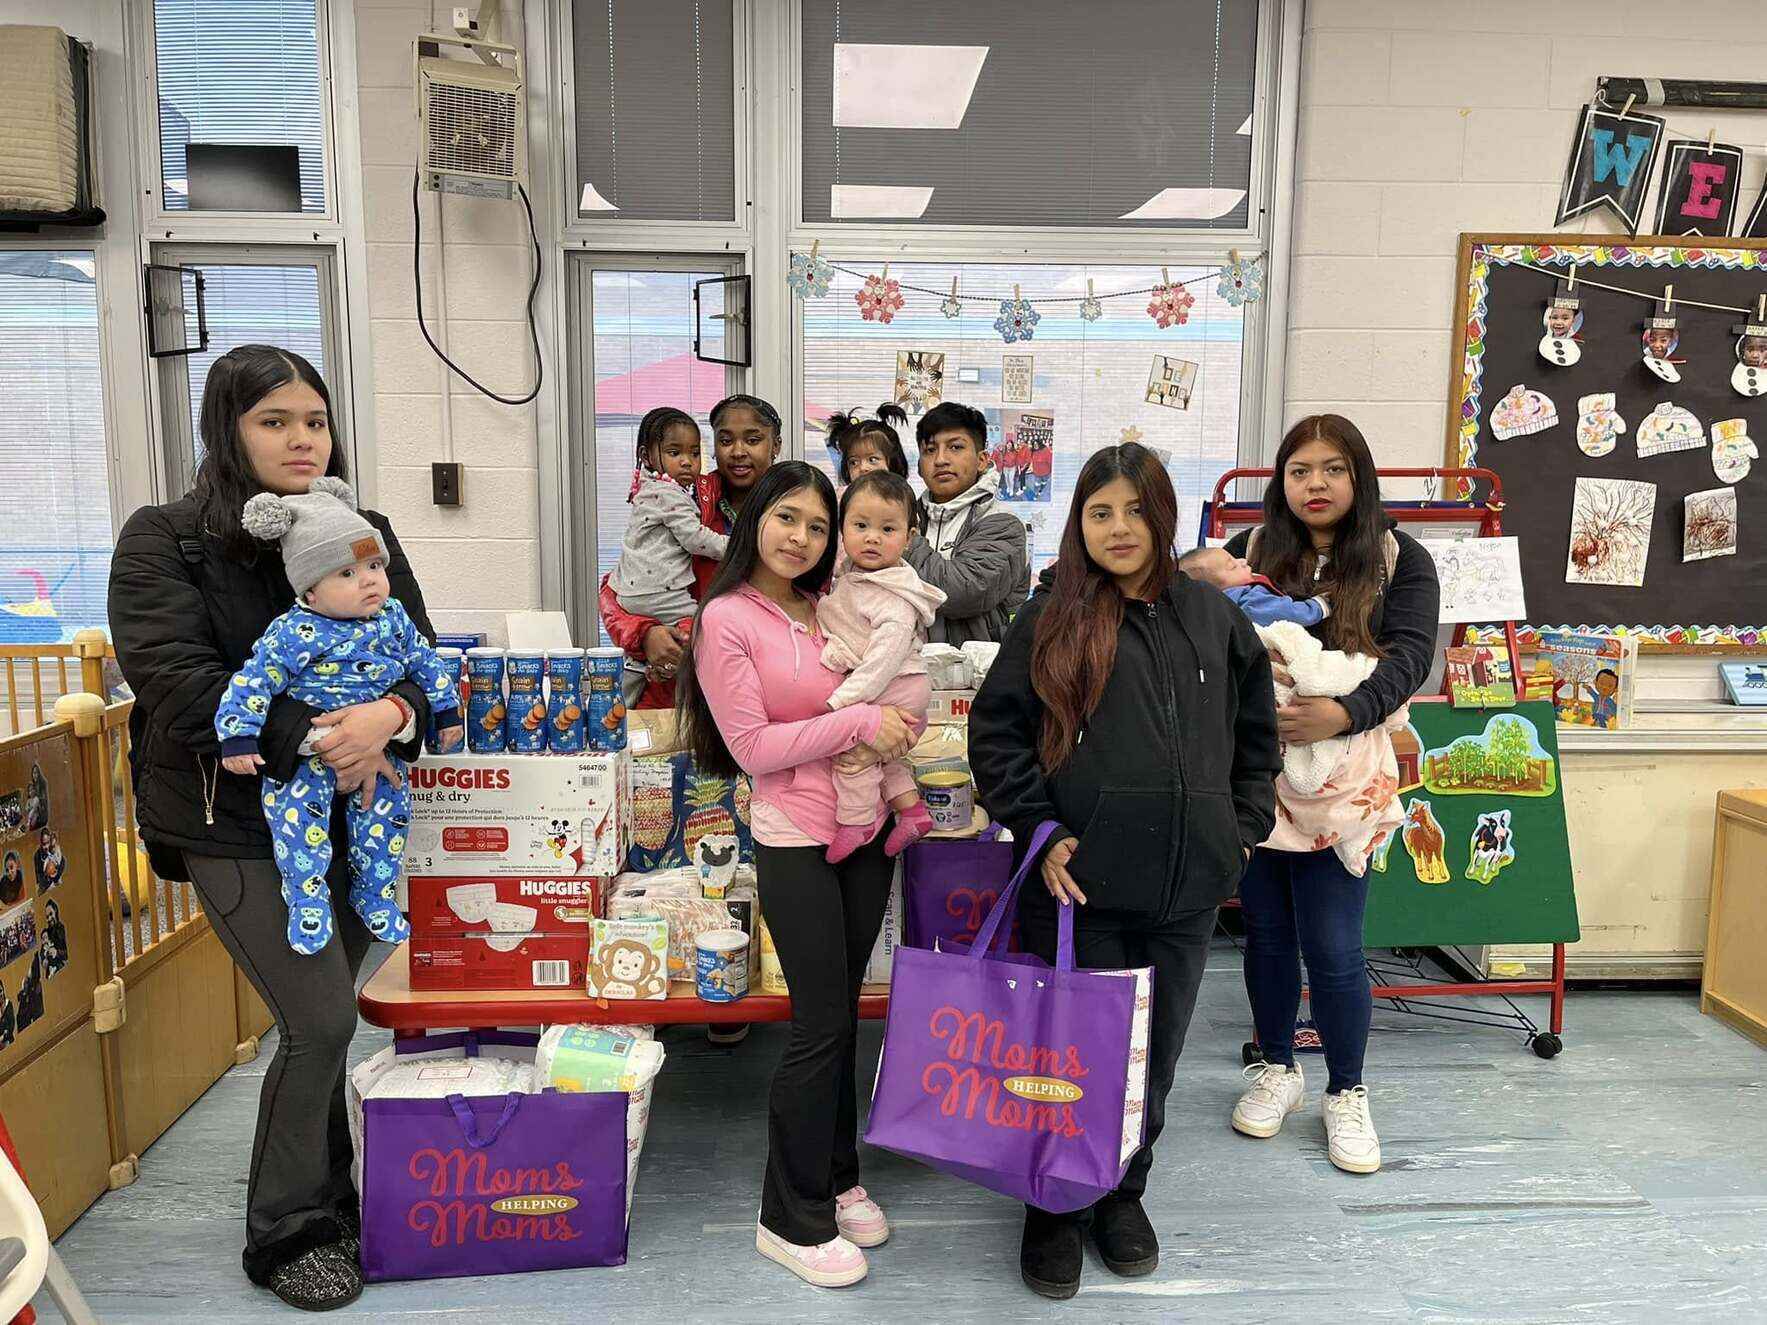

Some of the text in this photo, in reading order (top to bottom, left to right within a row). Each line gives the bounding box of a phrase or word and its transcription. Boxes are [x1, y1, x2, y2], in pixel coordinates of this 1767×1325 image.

[409, 791, 471, 804] nug & dry
[425, 857, 432, 867] 3
[520, 881, 591, 896] HUGGIES
[885, 918, 894, 926] &
[884, 927, 894, 955] Learn
[930, 1003, 1090, 1078] Moms
[1012, 1081, 1077, 1099] HELPING
[922, 1061, 1086, 1138] Moms
[408, 1149, 584, 1197] Moms
[501, 1198, 569, 1211] HELPING
[408, 1200, 583, 1248] Moms
